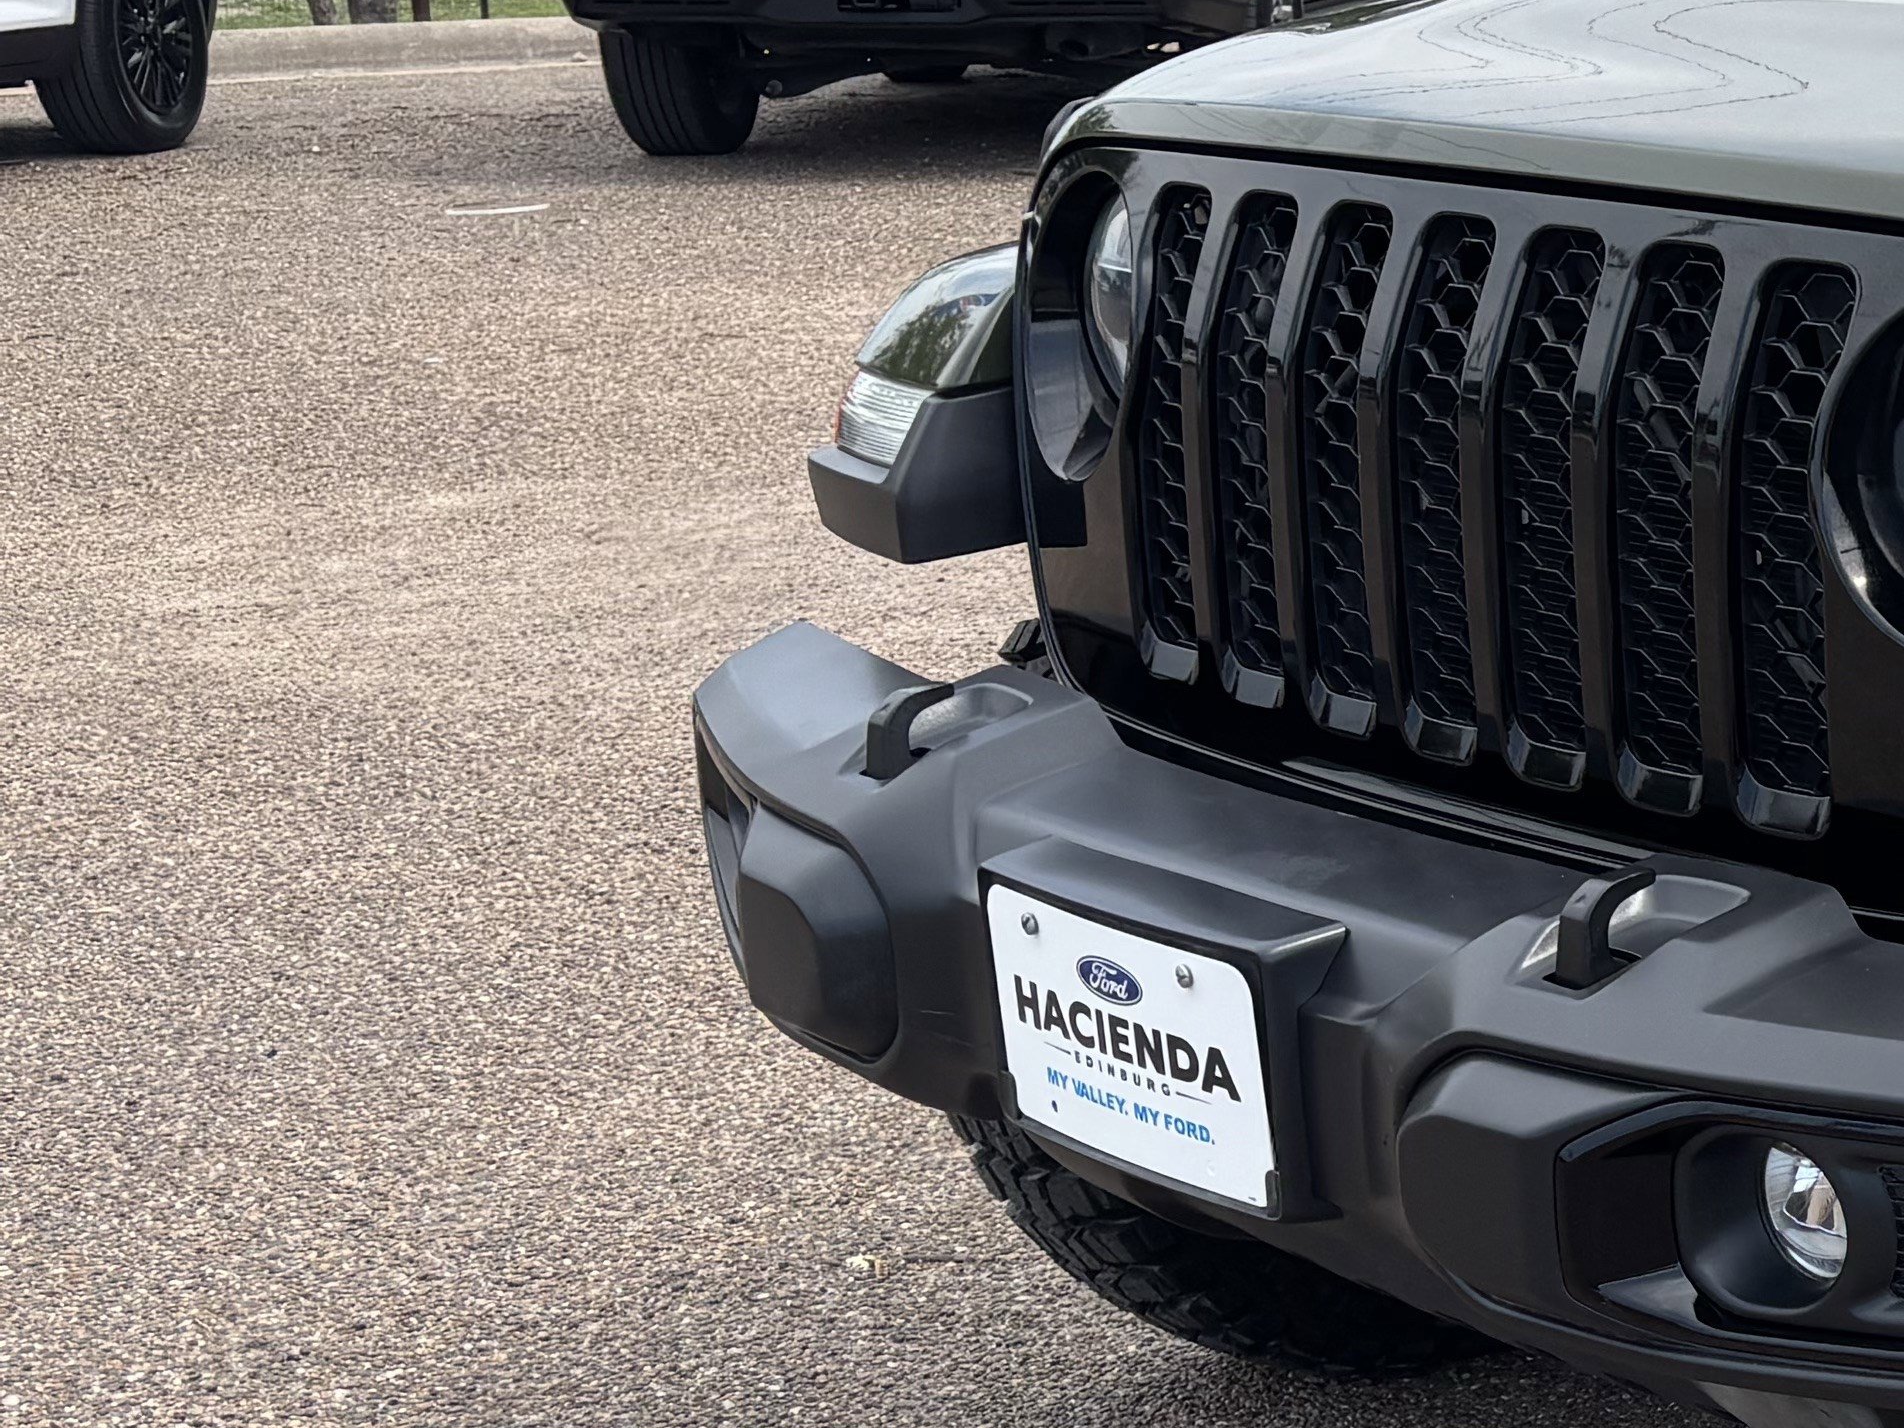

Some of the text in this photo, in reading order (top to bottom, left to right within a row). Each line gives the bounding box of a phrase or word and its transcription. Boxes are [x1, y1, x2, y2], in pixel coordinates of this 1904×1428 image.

[1087, 960, 1129, 1001] Ford
[1013, 974, 1242, 1103] HACIENDA
[1074, 1052, 1171, 1097] EDINBURG
[1047, 1066, 1216, 1147] MY VALLEY. MY FORD.
